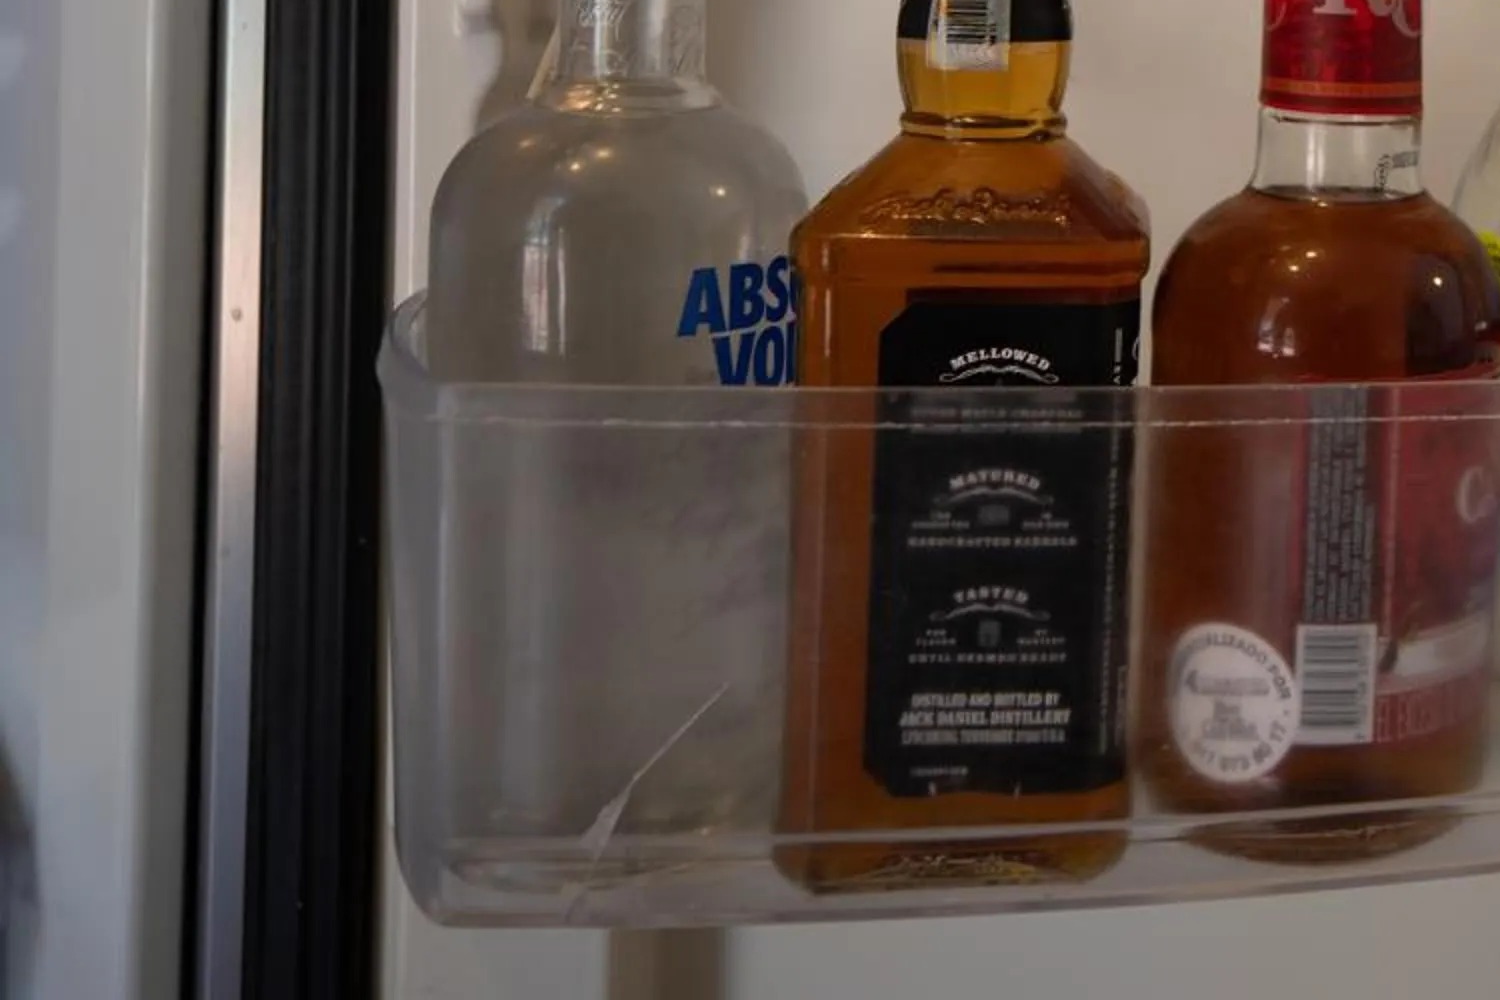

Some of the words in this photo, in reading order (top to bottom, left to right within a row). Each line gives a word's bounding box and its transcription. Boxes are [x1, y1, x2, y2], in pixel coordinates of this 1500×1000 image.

[949, 348, 1051, 372] MELLOWED
[949, 469, 1041, 491] MATURED
[899, 710, 935, 727] JACK
[937, 709, 988, 726] DANIEL
